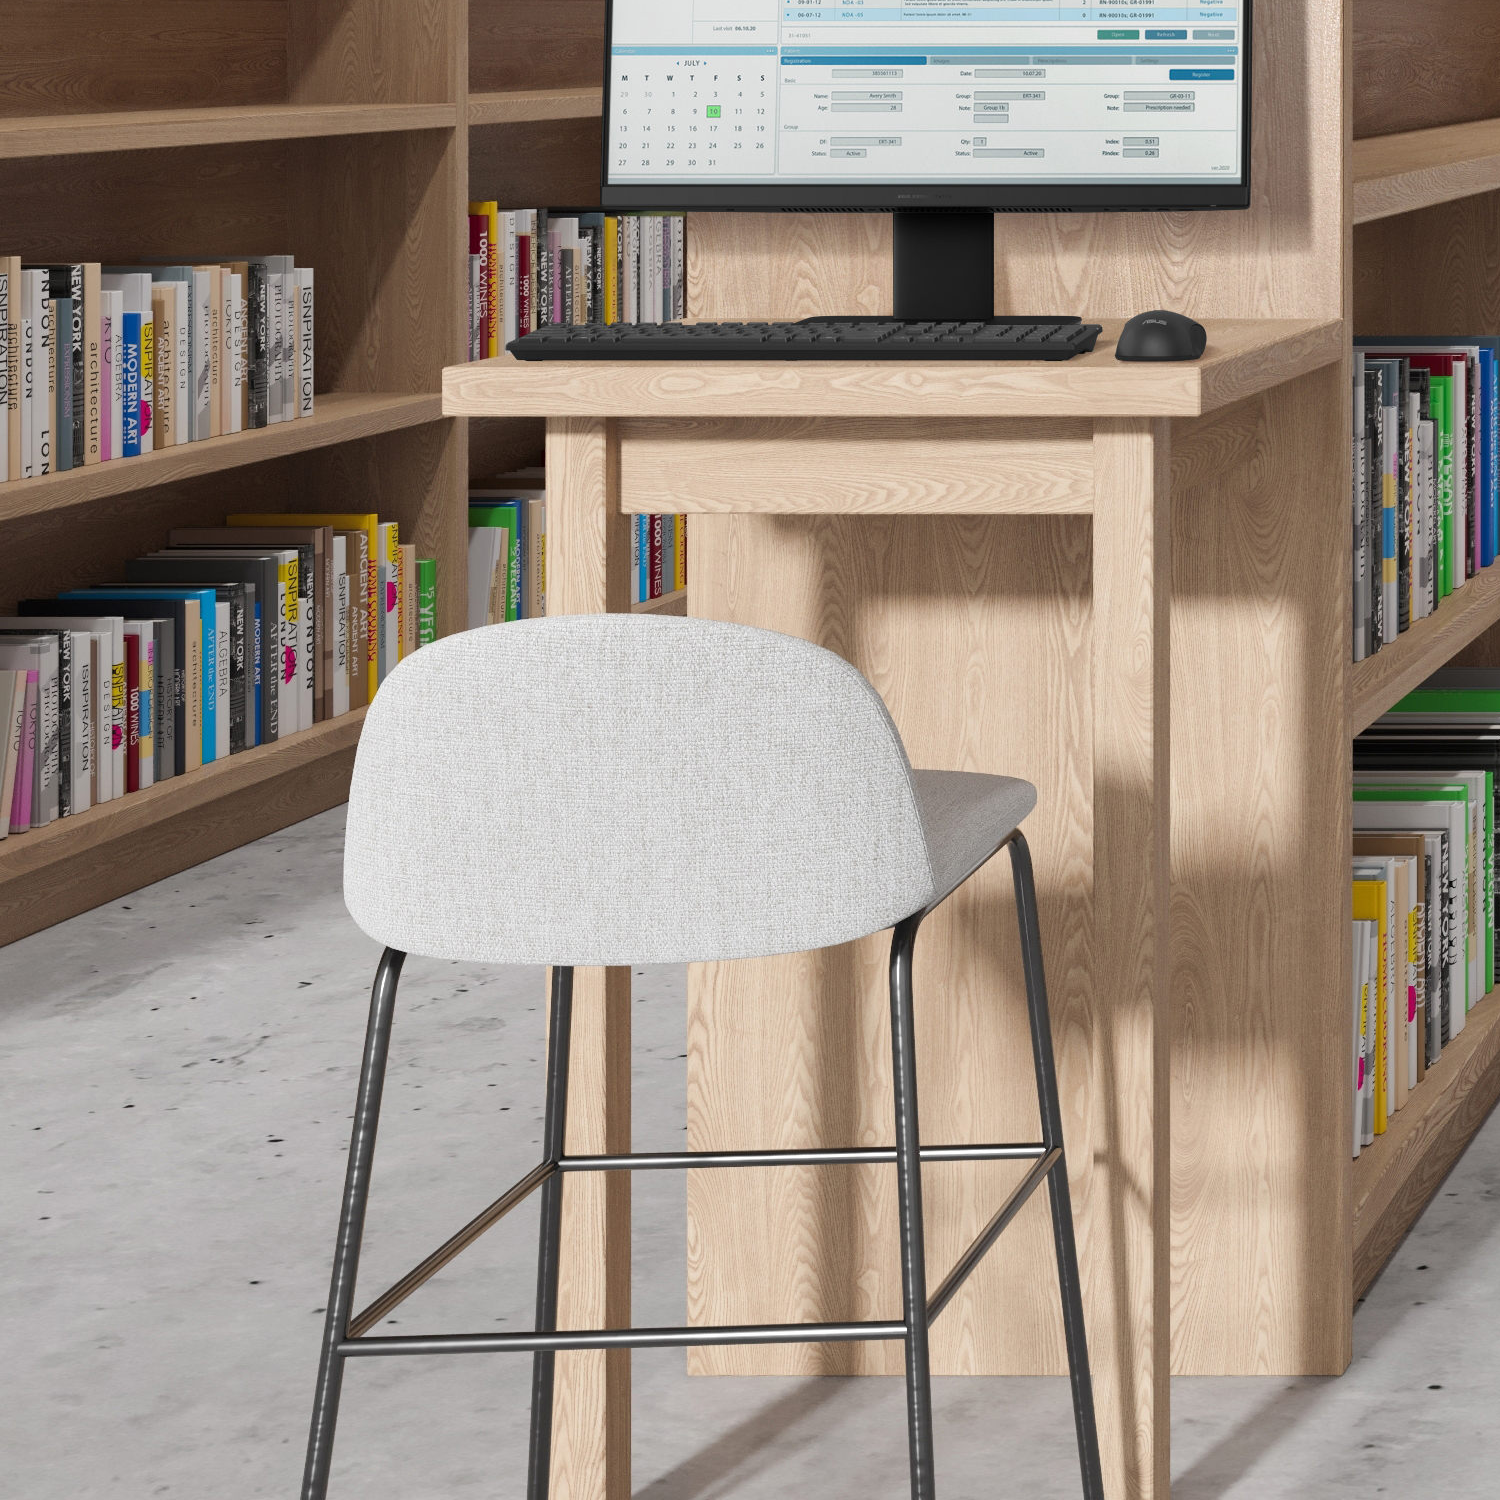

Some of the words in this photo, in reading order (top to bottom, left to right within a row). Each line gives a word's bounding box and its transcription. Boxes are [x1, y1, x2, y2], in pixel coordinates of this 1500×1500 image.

[479, 231, 487, 267] 1000
[71, 265, 81, 301] NEW
[479, 271, 487, 318] WINES
[71, 303, 81, 352] YORK
[274, 285, 283, 384] PHOTOGRAPHY
[303, 286, 312, 411] ISNPIRATION
[90, 343, 98, 454] architecture
[127, 343, 137, 412] MODERN
[127, 417, 137, 445] ART
[359, 534, 368, 605] ANCIENT
[288, 559, 297, 677] ISNPIRATION
[360, 609, 368, 639] ART
[219, 631, 228, 698] ALGEBRA
[130, 687, 139, 711] 1000
[131, 713, 139, 746] WINES
[1442, 842, 1450, 893] NEW
[1442, 902, 1450, 968] YORK
